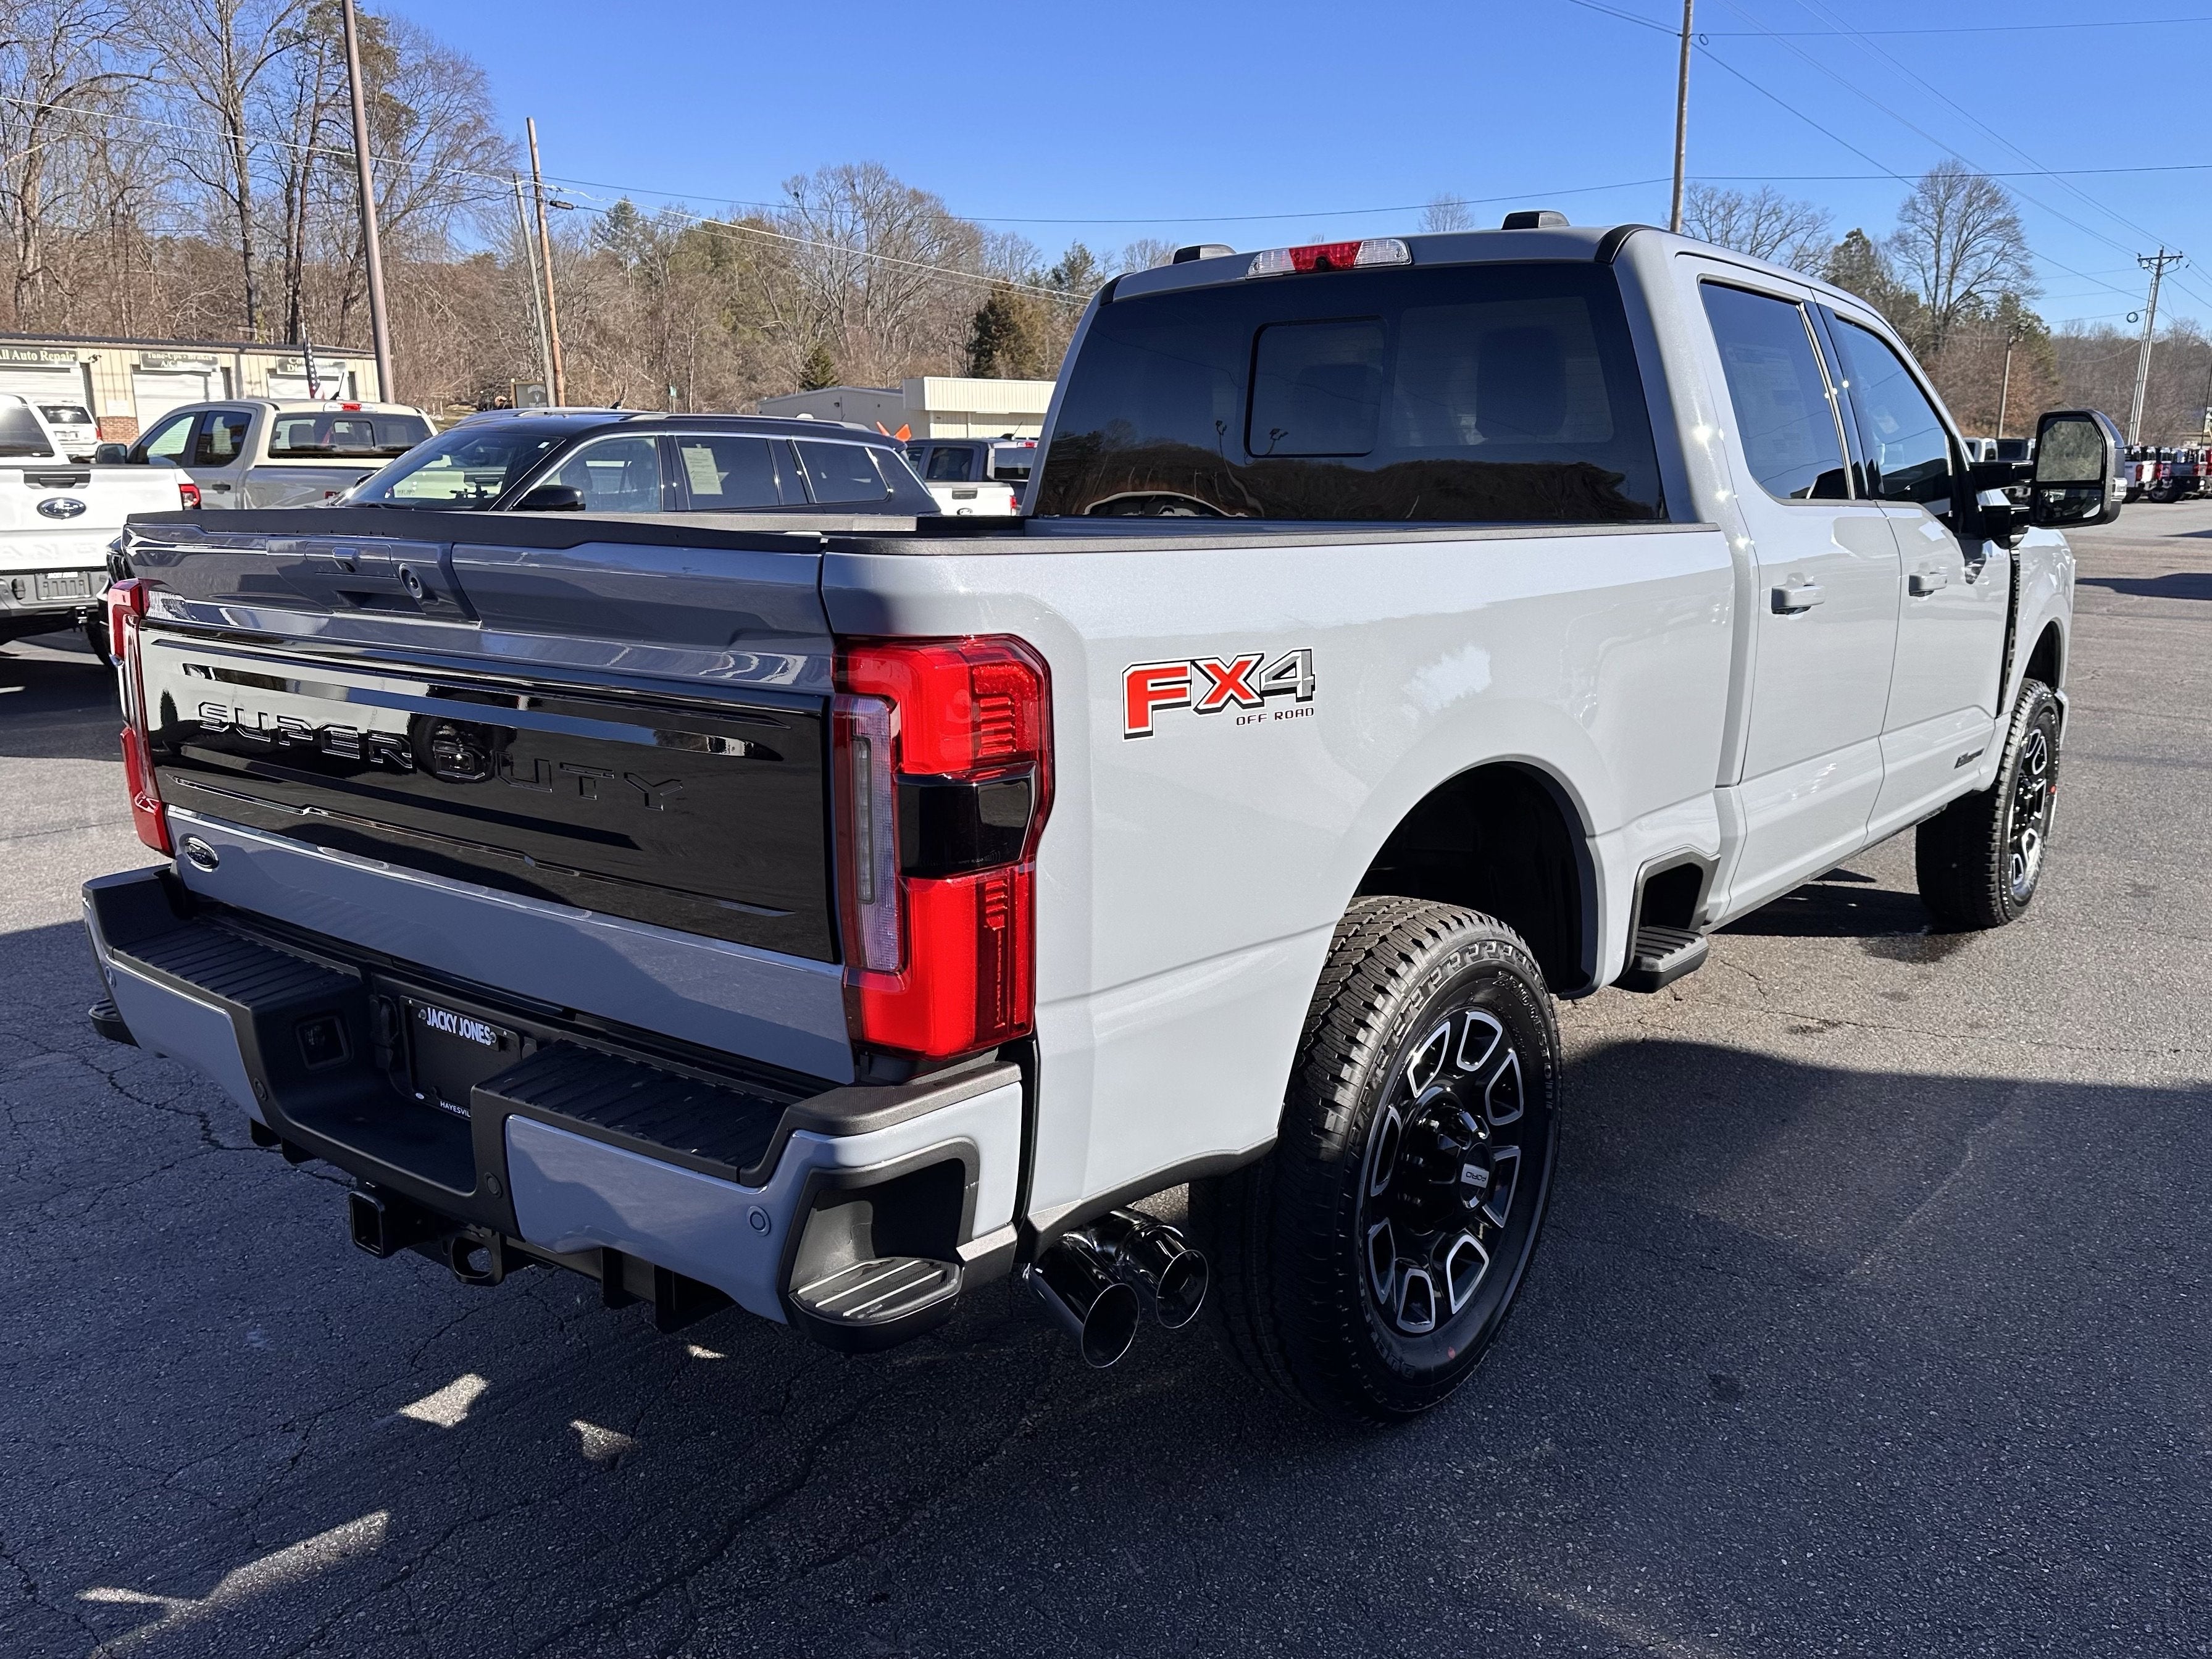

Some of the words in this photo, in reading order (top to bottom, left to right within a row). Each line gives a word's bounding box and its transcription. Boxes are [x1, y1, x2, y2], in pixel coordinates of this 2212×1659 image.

[0, 349, 10, 360] ll
[12, 349, 38, 361] Auto
[40, 350, 75, 364] Repair
[1121, 647, 1316, 742] FX4
[1236, 713, 1267, 726] OFF
[1274, 707, 1314, 721] ROAD
[198, 701, 413, 769] SUPER
[433, 740, 683, 811] DUTY
[426, 1007, 457, 1034] JACKY
[459, 1017, 492, 1046] JONES
[1466, 1171, 1487, 1182] FORD
